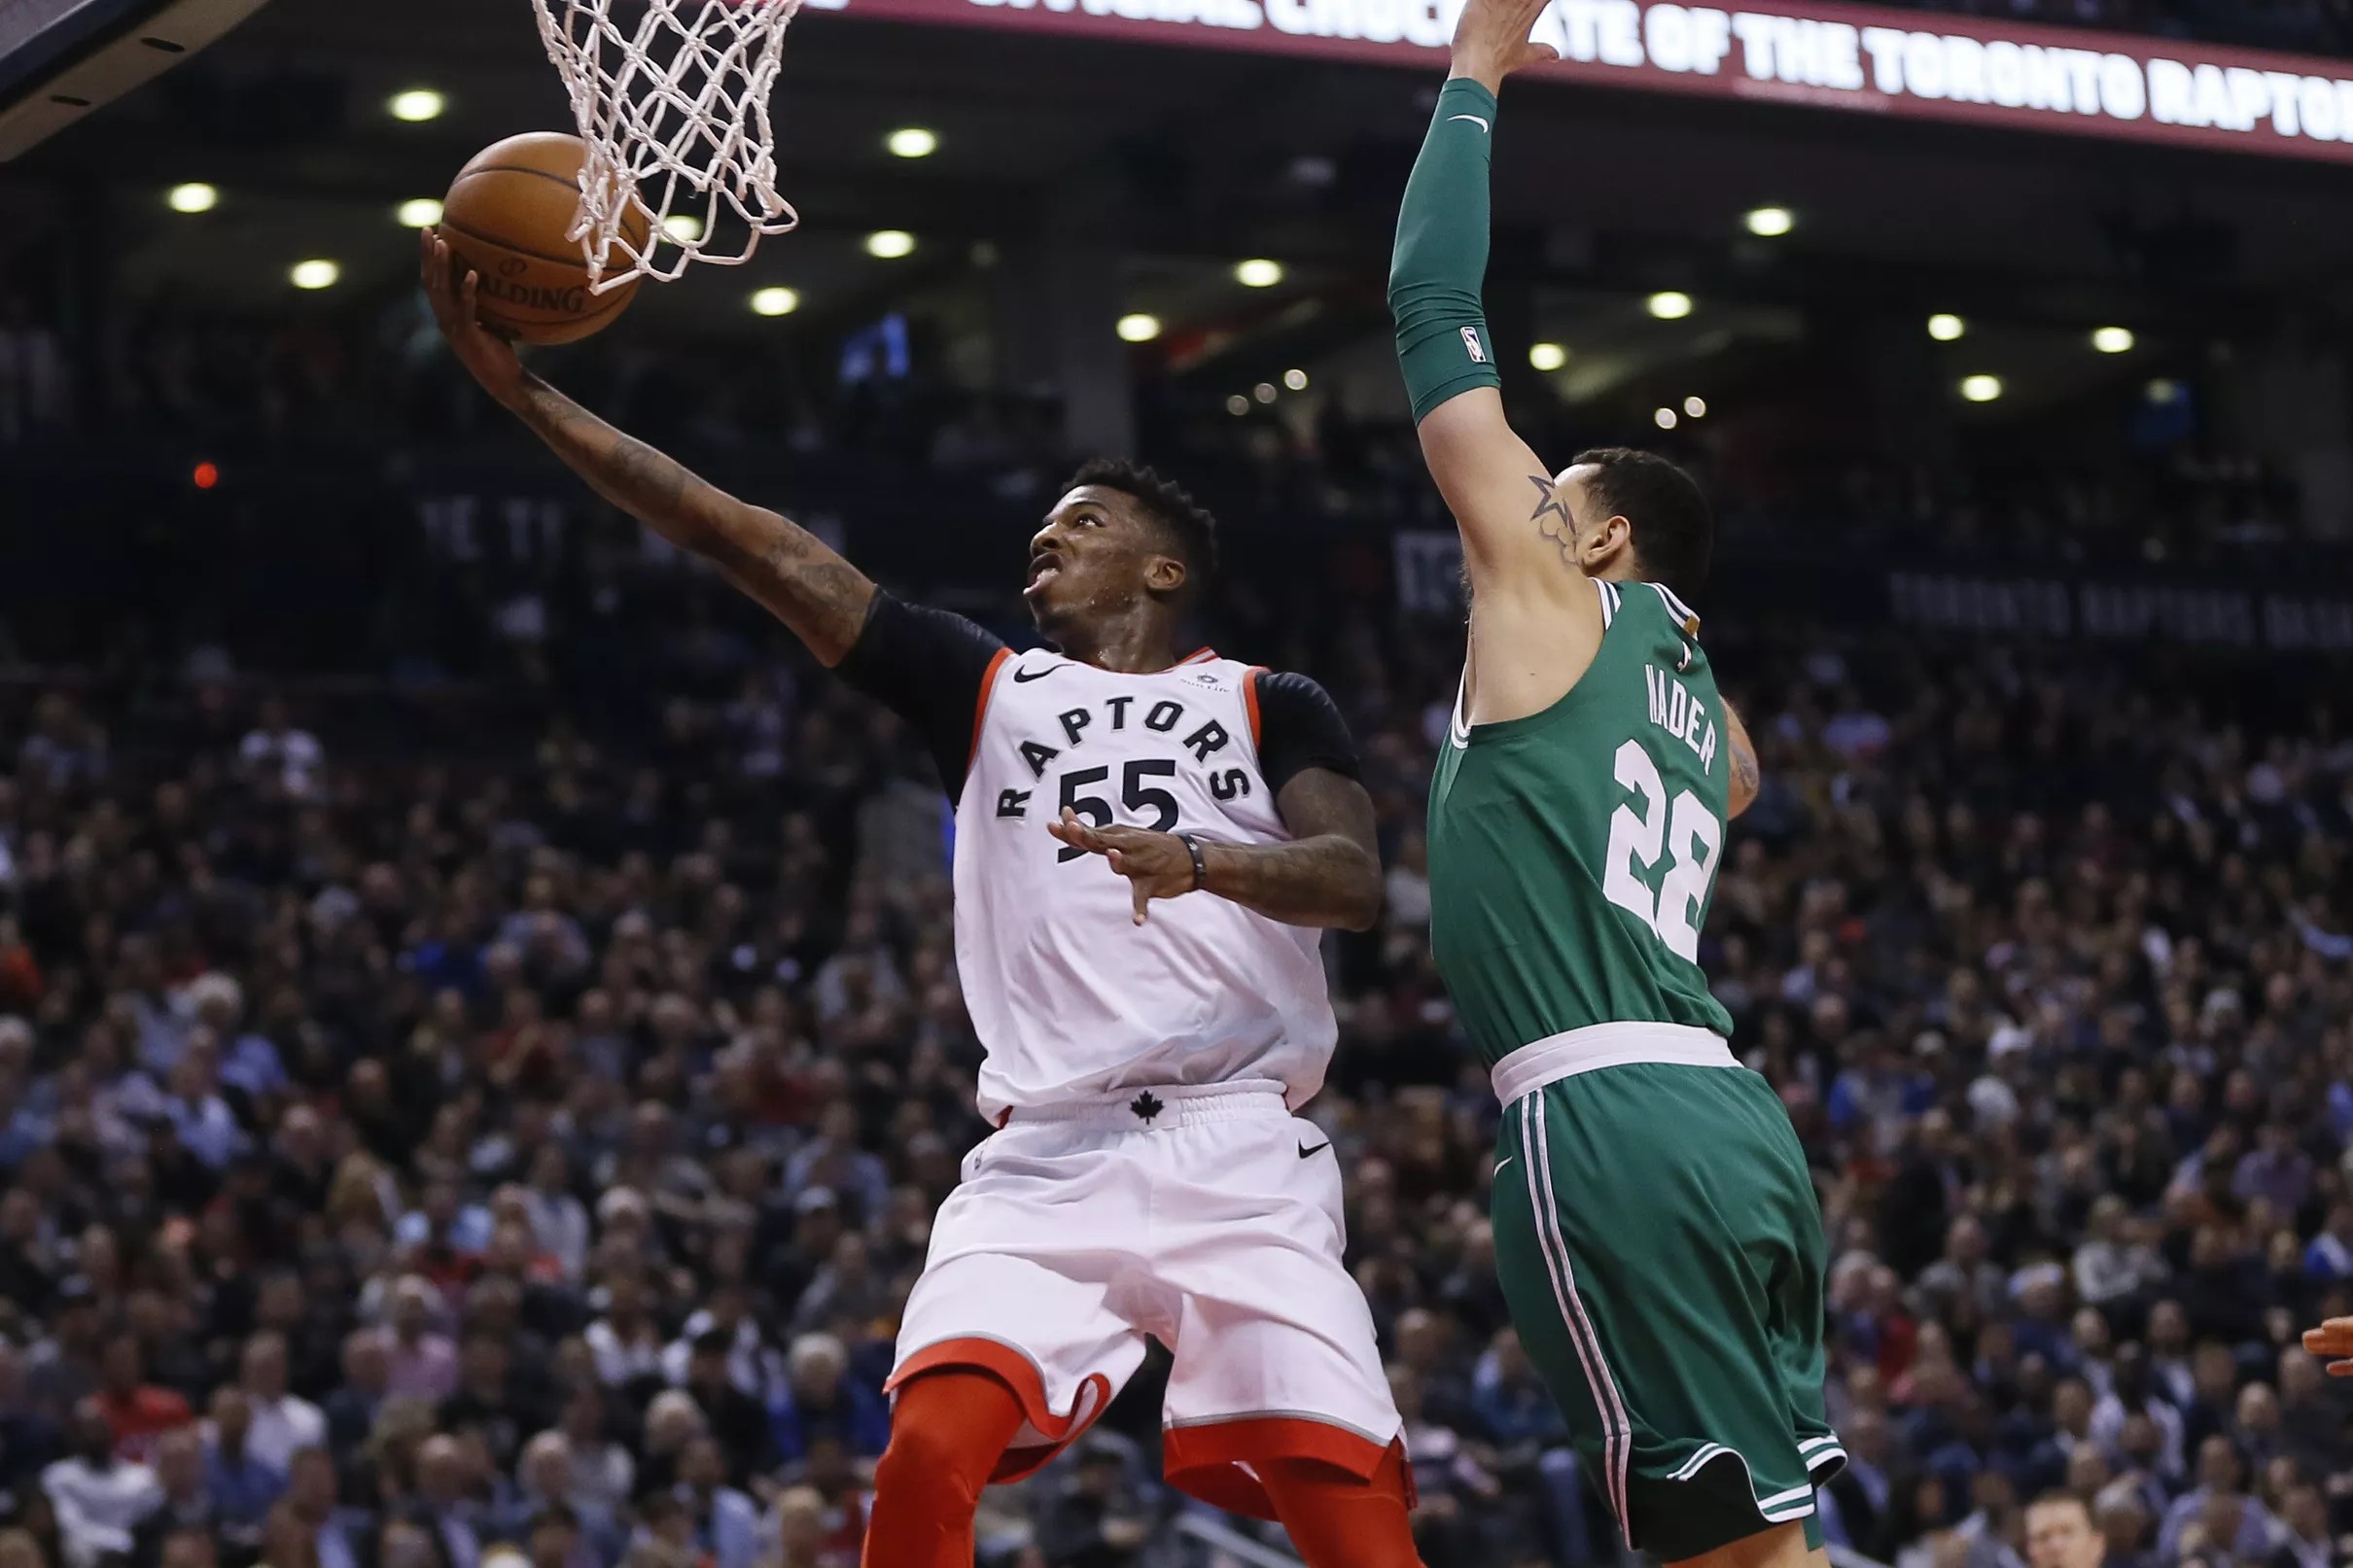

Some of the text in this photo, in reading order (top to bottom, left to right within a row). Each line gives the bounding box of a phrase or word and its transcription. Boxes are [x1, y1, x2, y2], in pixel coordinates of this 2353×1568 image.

[1645, 4, 1730, 74] OF
[1734, 13, 1864, 89] THE
[1862, 27, 2145, 120] TORONTO
[997, 697, 1249, 817] RAPTORS
[1058, 759, 1178, 863] 55
[1602, 739, 1721, 965] 28
